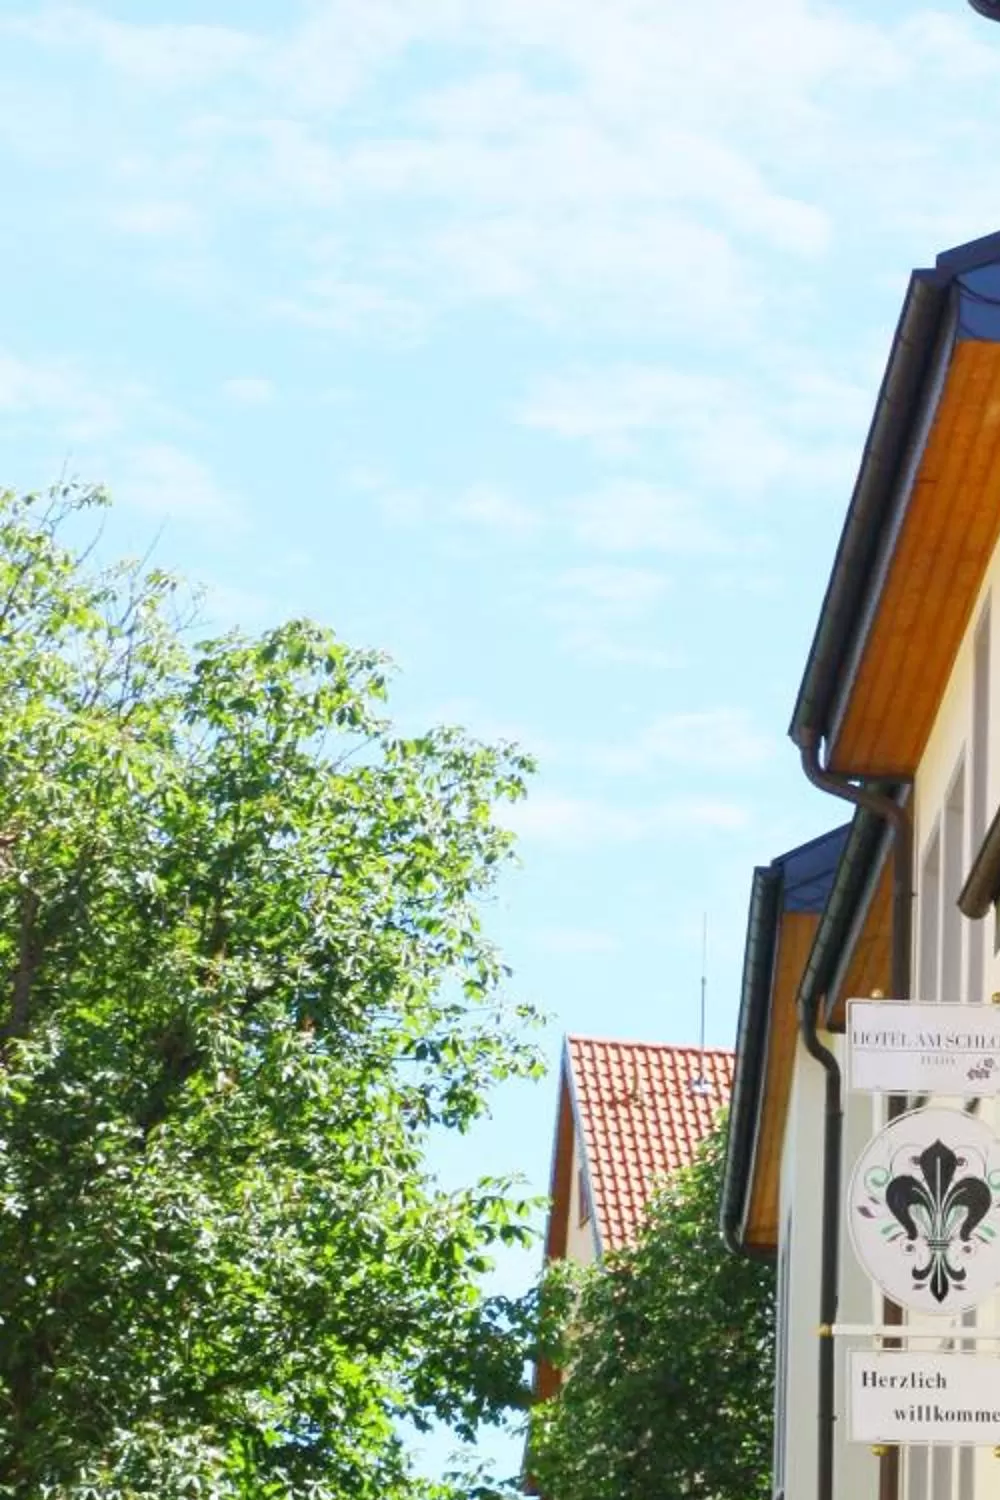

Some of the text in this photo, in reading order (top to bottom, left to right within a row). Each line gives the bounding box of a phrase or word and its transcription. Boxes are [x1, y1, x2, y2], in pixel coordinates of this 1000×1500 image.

[853, 1031, 911, 1047] HOTEL
[914, 1033, 941, 1047] AM
[862, 1371, 948, 1389] Herzlich
